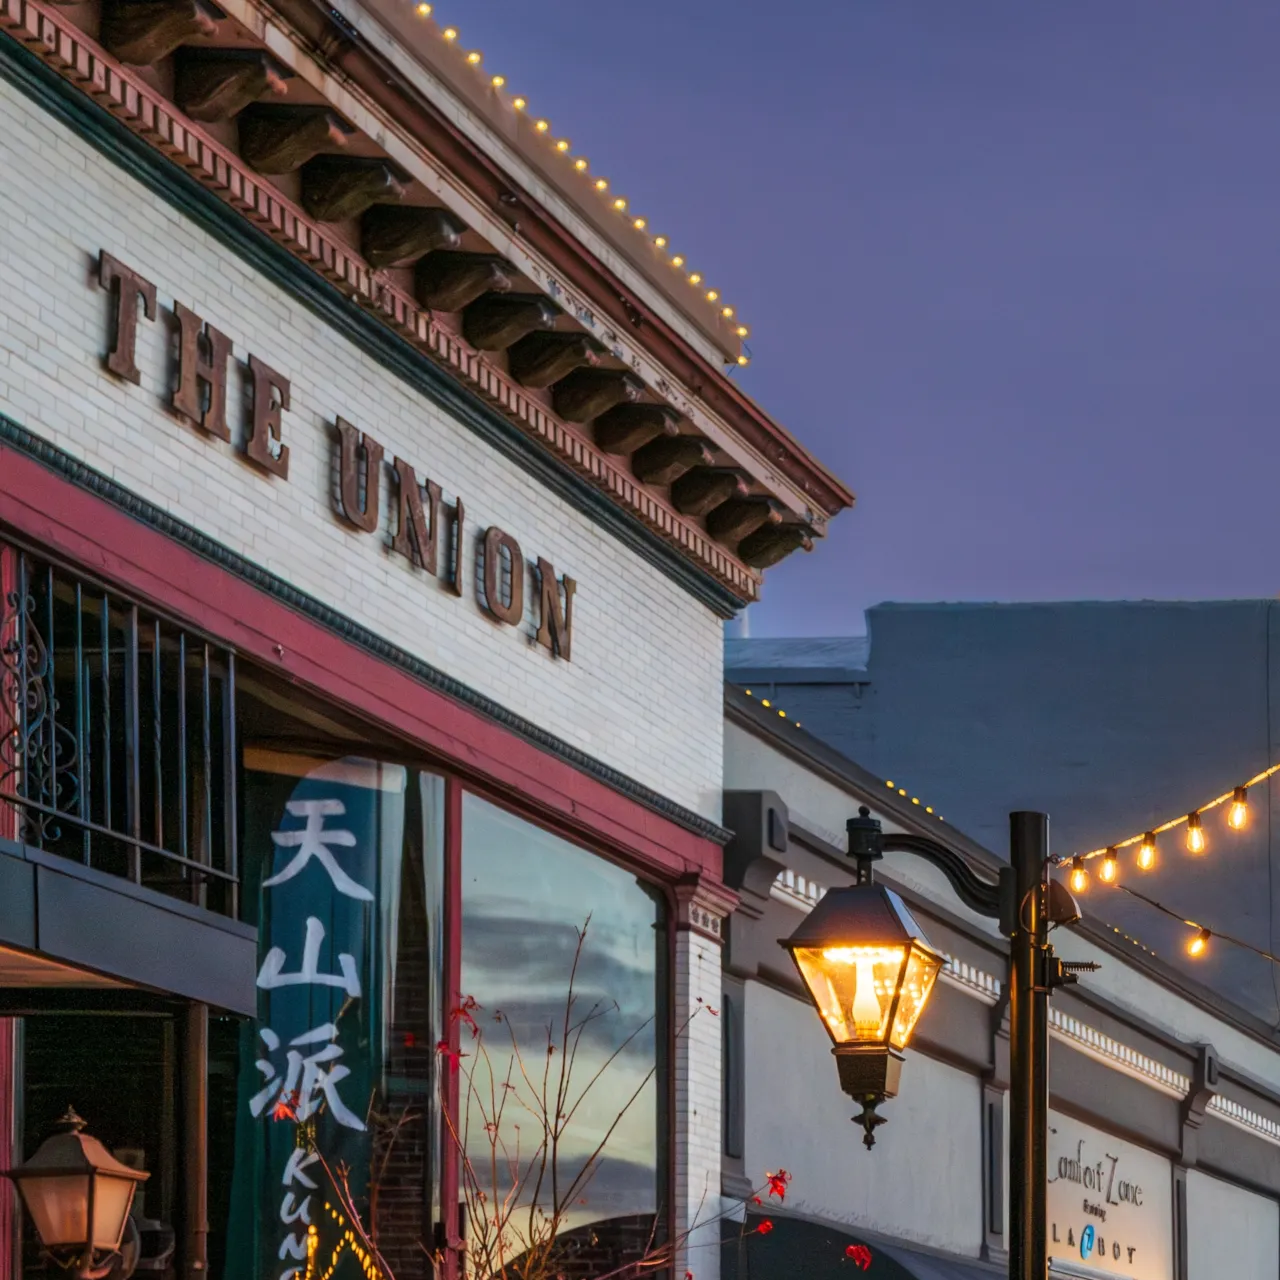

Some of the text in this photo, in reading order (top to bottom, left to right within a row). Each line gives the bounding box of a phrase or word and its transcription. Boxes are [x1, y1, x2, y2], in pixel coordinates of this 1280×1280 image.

[98, 248, 578, 662] THE UNION
[247, 797, 374, 1133] 天山派
[1048, 1126, 1143, 1207] omfort Zone
